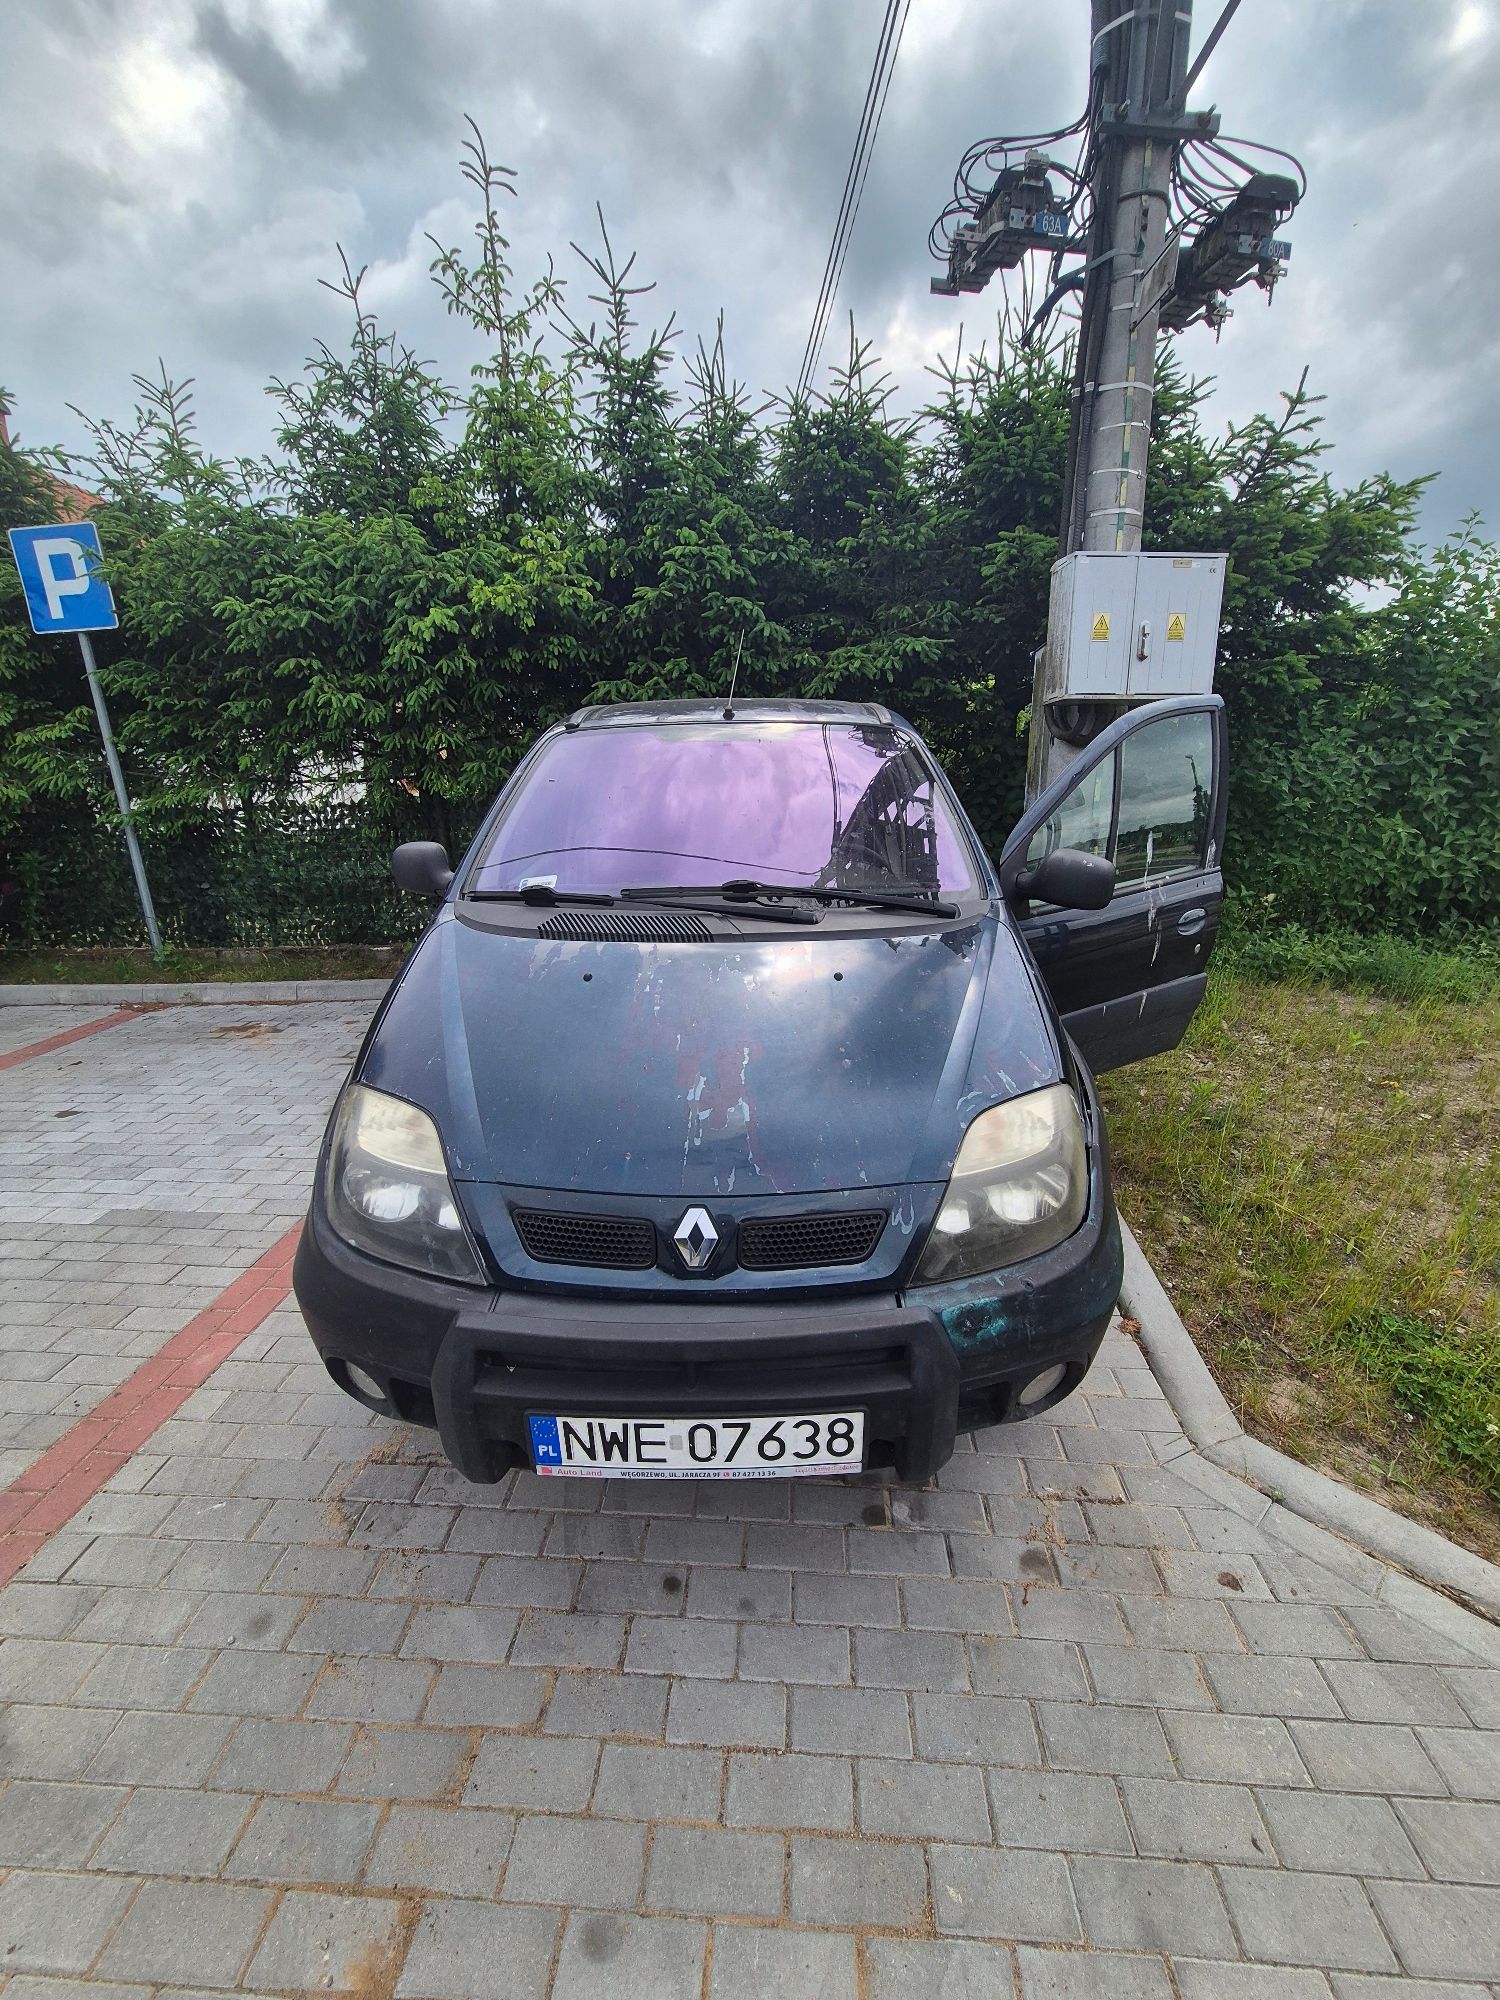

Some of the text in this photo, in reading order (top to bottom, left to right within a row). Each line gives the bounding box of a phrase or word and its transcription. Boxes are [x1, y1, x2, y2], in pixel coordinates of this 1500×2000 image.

[1042, 215, 1062, 233] 63A
[1268, 240, 1285, 258] 80A
[32, 537, 90, 620] P
[562, 1417, 856, 1463] NWE 07638
[538, 1444, 558, 1457] PL
[557, 1468, 603, 1477] Auto Land
[620, 1471, 667, 1479] WĘGORZEWO,
